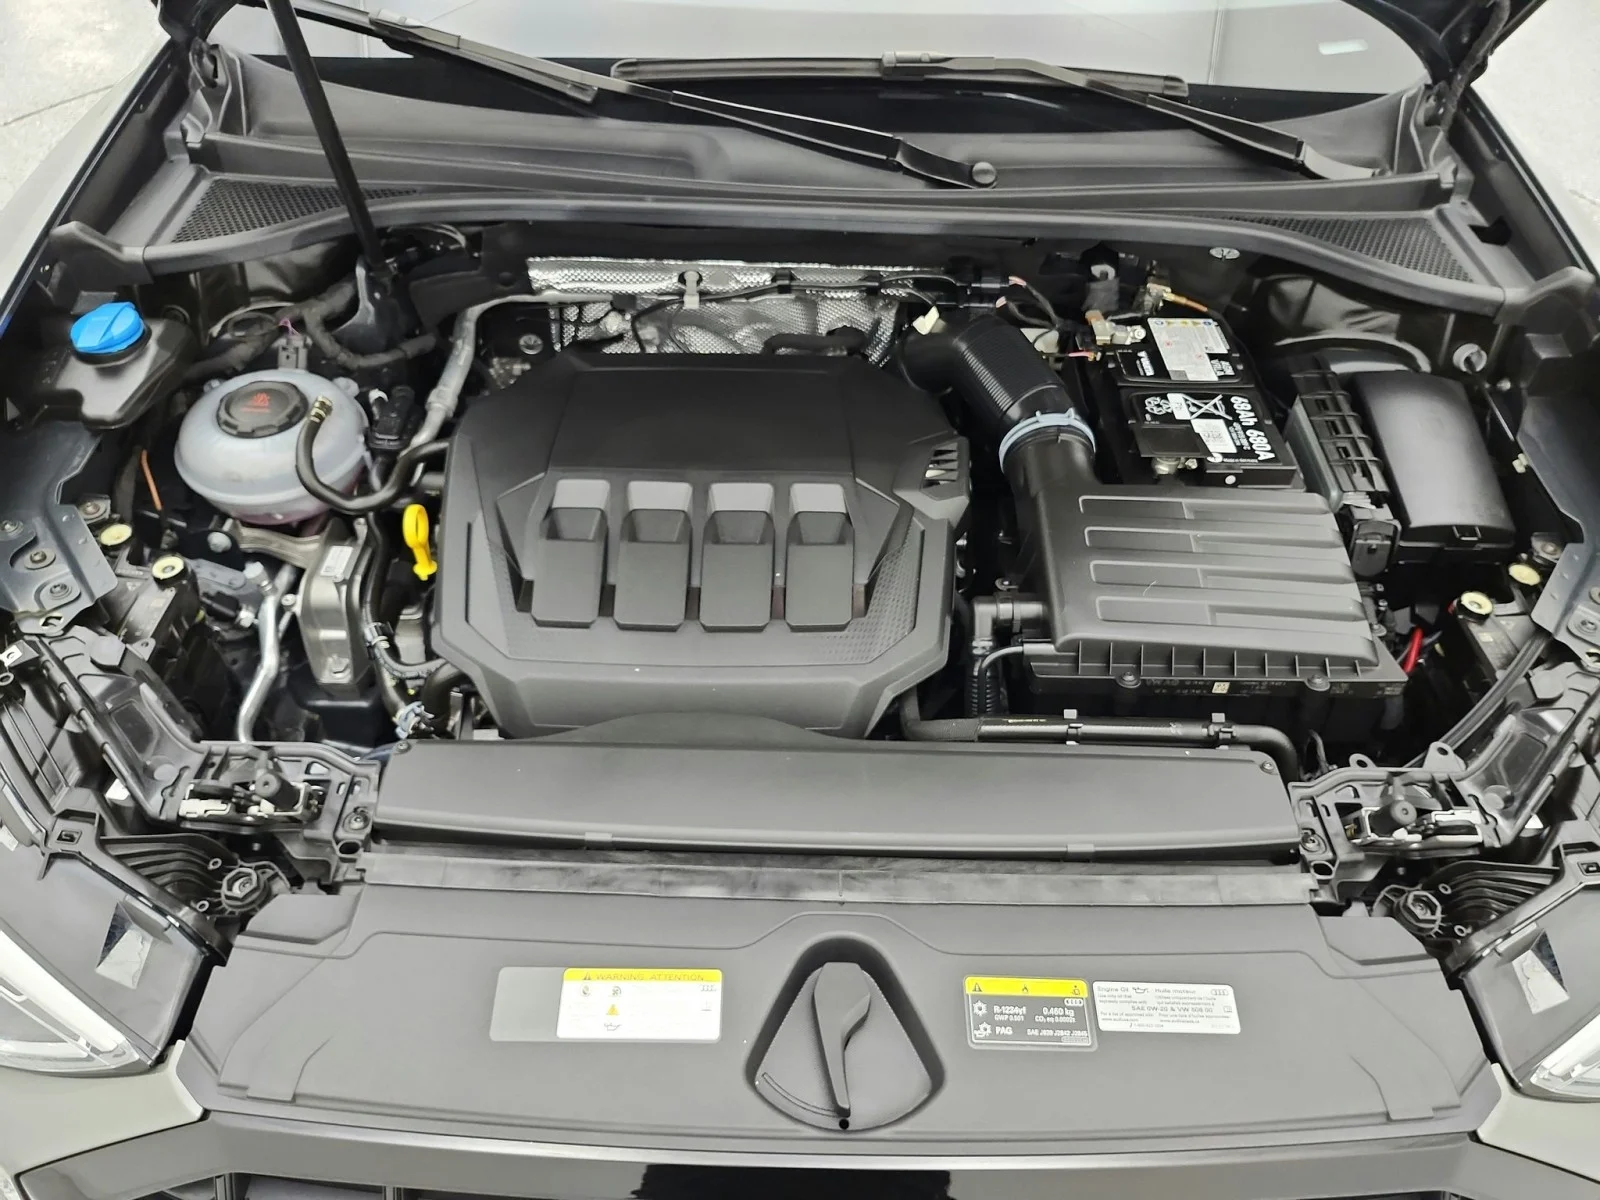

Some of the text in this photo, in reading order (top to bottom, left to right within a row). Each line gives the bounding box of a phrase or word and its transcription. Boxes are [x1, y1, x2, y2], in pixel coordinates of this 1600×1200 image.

[1230, 395, 1258, 426] 68Ah
[1245, 428, 1275, 461] 680A
[596, 973, 704, 981] WARNING ATTENTION
[993, 1005, 1026, 1015] R-1234yf
[1064, 1008, 1075, 1017] kg
[996, 1026, 1013, 1035] PAG
